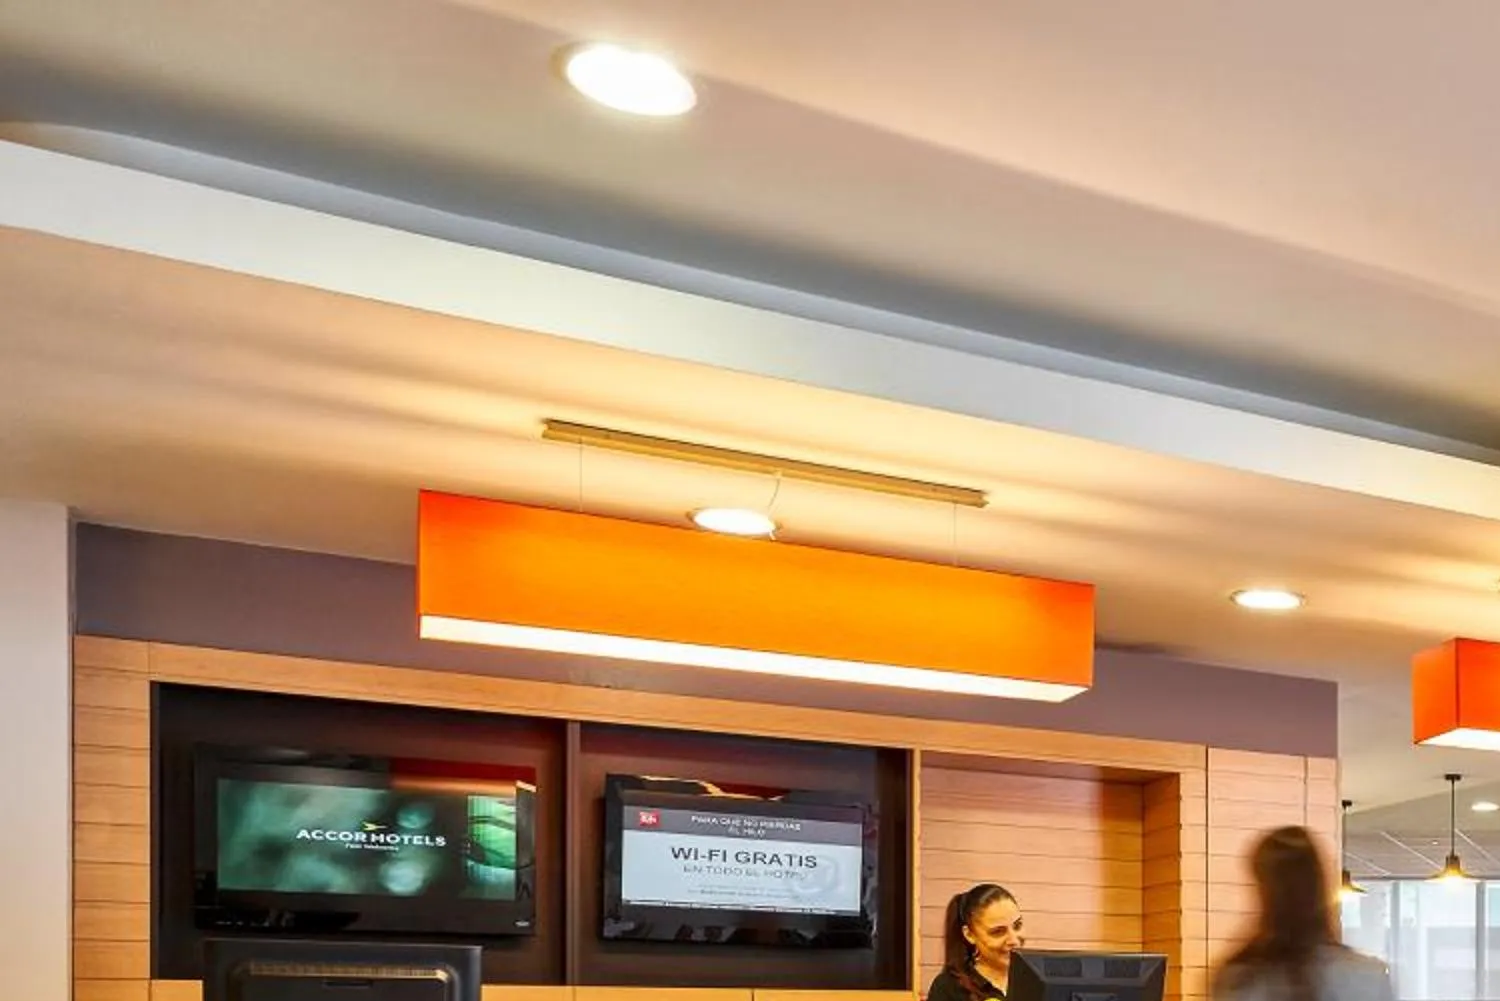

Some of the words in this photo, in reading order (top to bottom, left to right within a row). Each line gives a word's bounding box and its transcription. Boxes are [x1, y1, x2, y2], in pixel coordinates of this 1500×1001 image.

[296, 829, 367, 843] ACCOR
[370, 833, 446, 847] HOTELS
[671, 847, 727, 863] WI-FI
[735, 851, 817, 868] GRATIS
[706, 866, 743, 876] TODO
